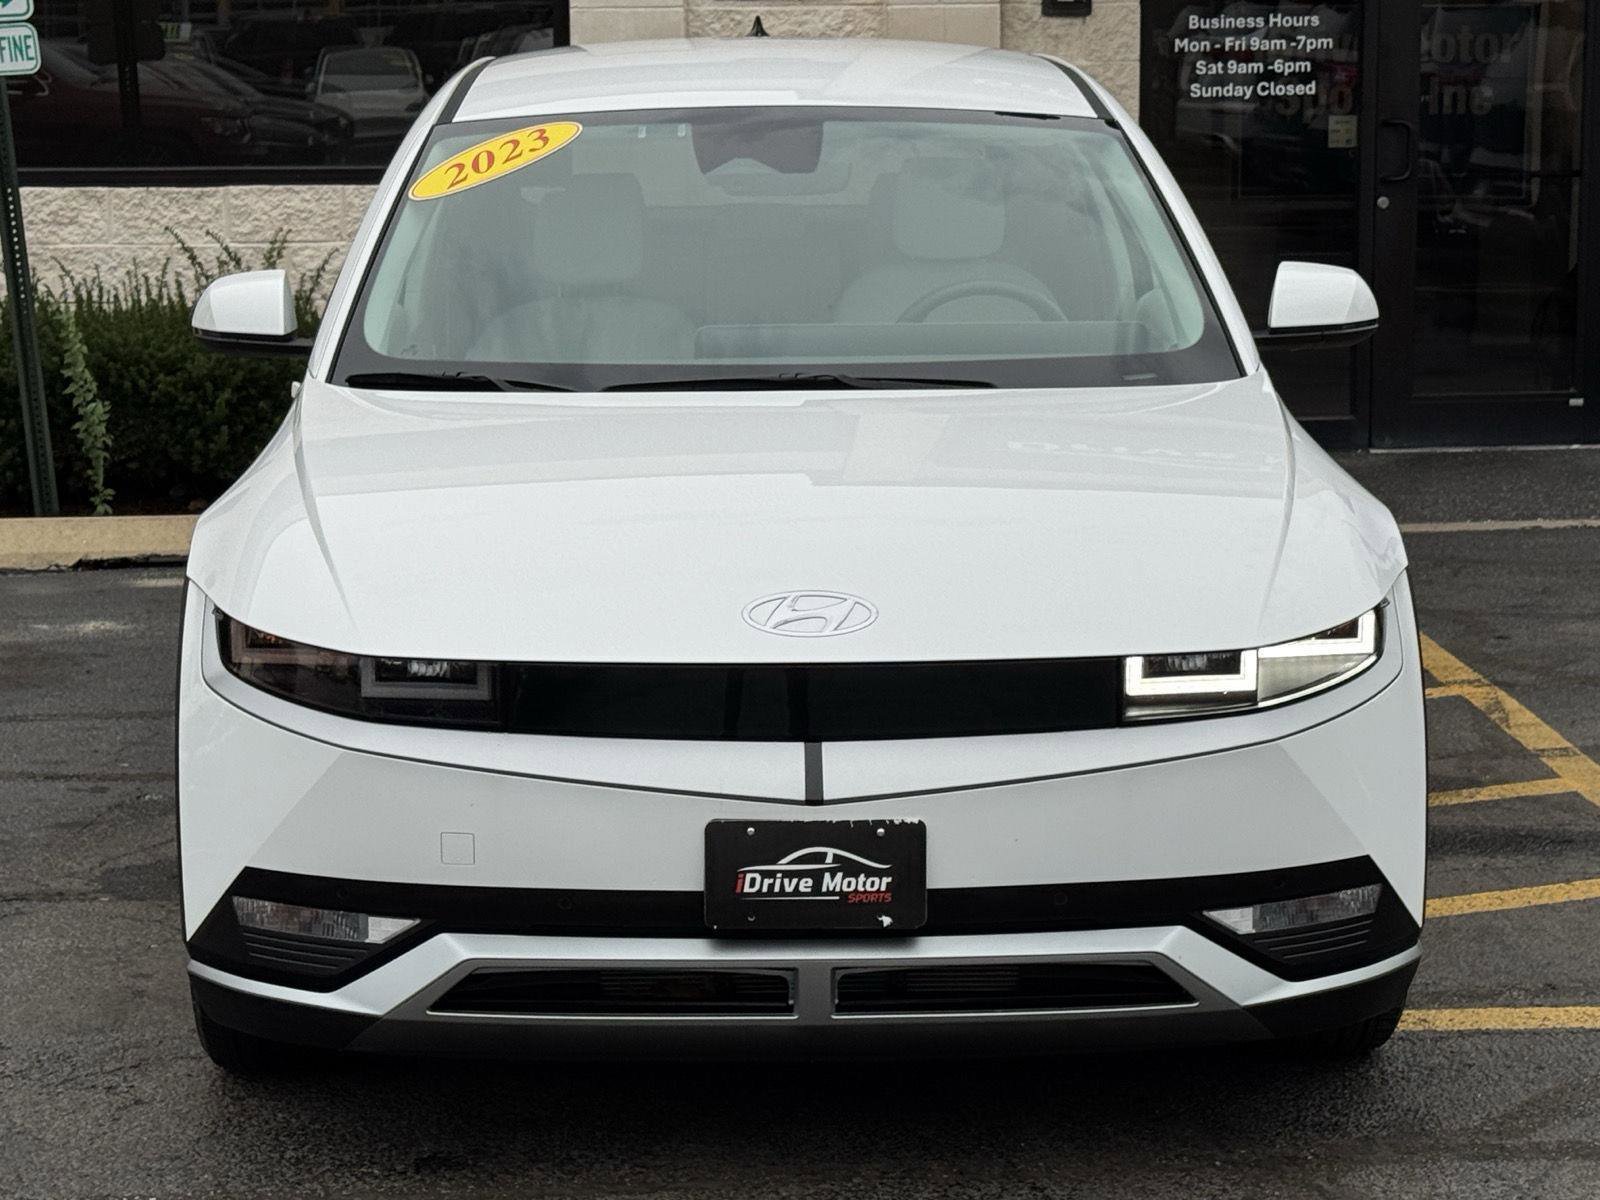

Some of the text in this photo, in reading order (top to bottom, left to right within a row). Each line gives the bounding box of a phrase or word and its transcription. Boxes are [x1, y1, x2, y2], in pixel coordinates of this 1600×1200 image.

[1188, 13, 1320, 30] Business Hours
[0, 34, 34, 63] FINE
[1174, 37, 1211, 53] Mon
[1224, 36, 1247, 52] Fri
[1249, 36, 1287, 51] 9am
[1195, 60, 1225, 75] Sat
[1226, 60, 1264, 74] 9am
[1189, 80, 1317, 100] Sunday Closed
[443, 127, 551, 190] 2023
[735, 871, 893, 894] iDrive Motor
[847, 892, 893, 904] SPORTS
